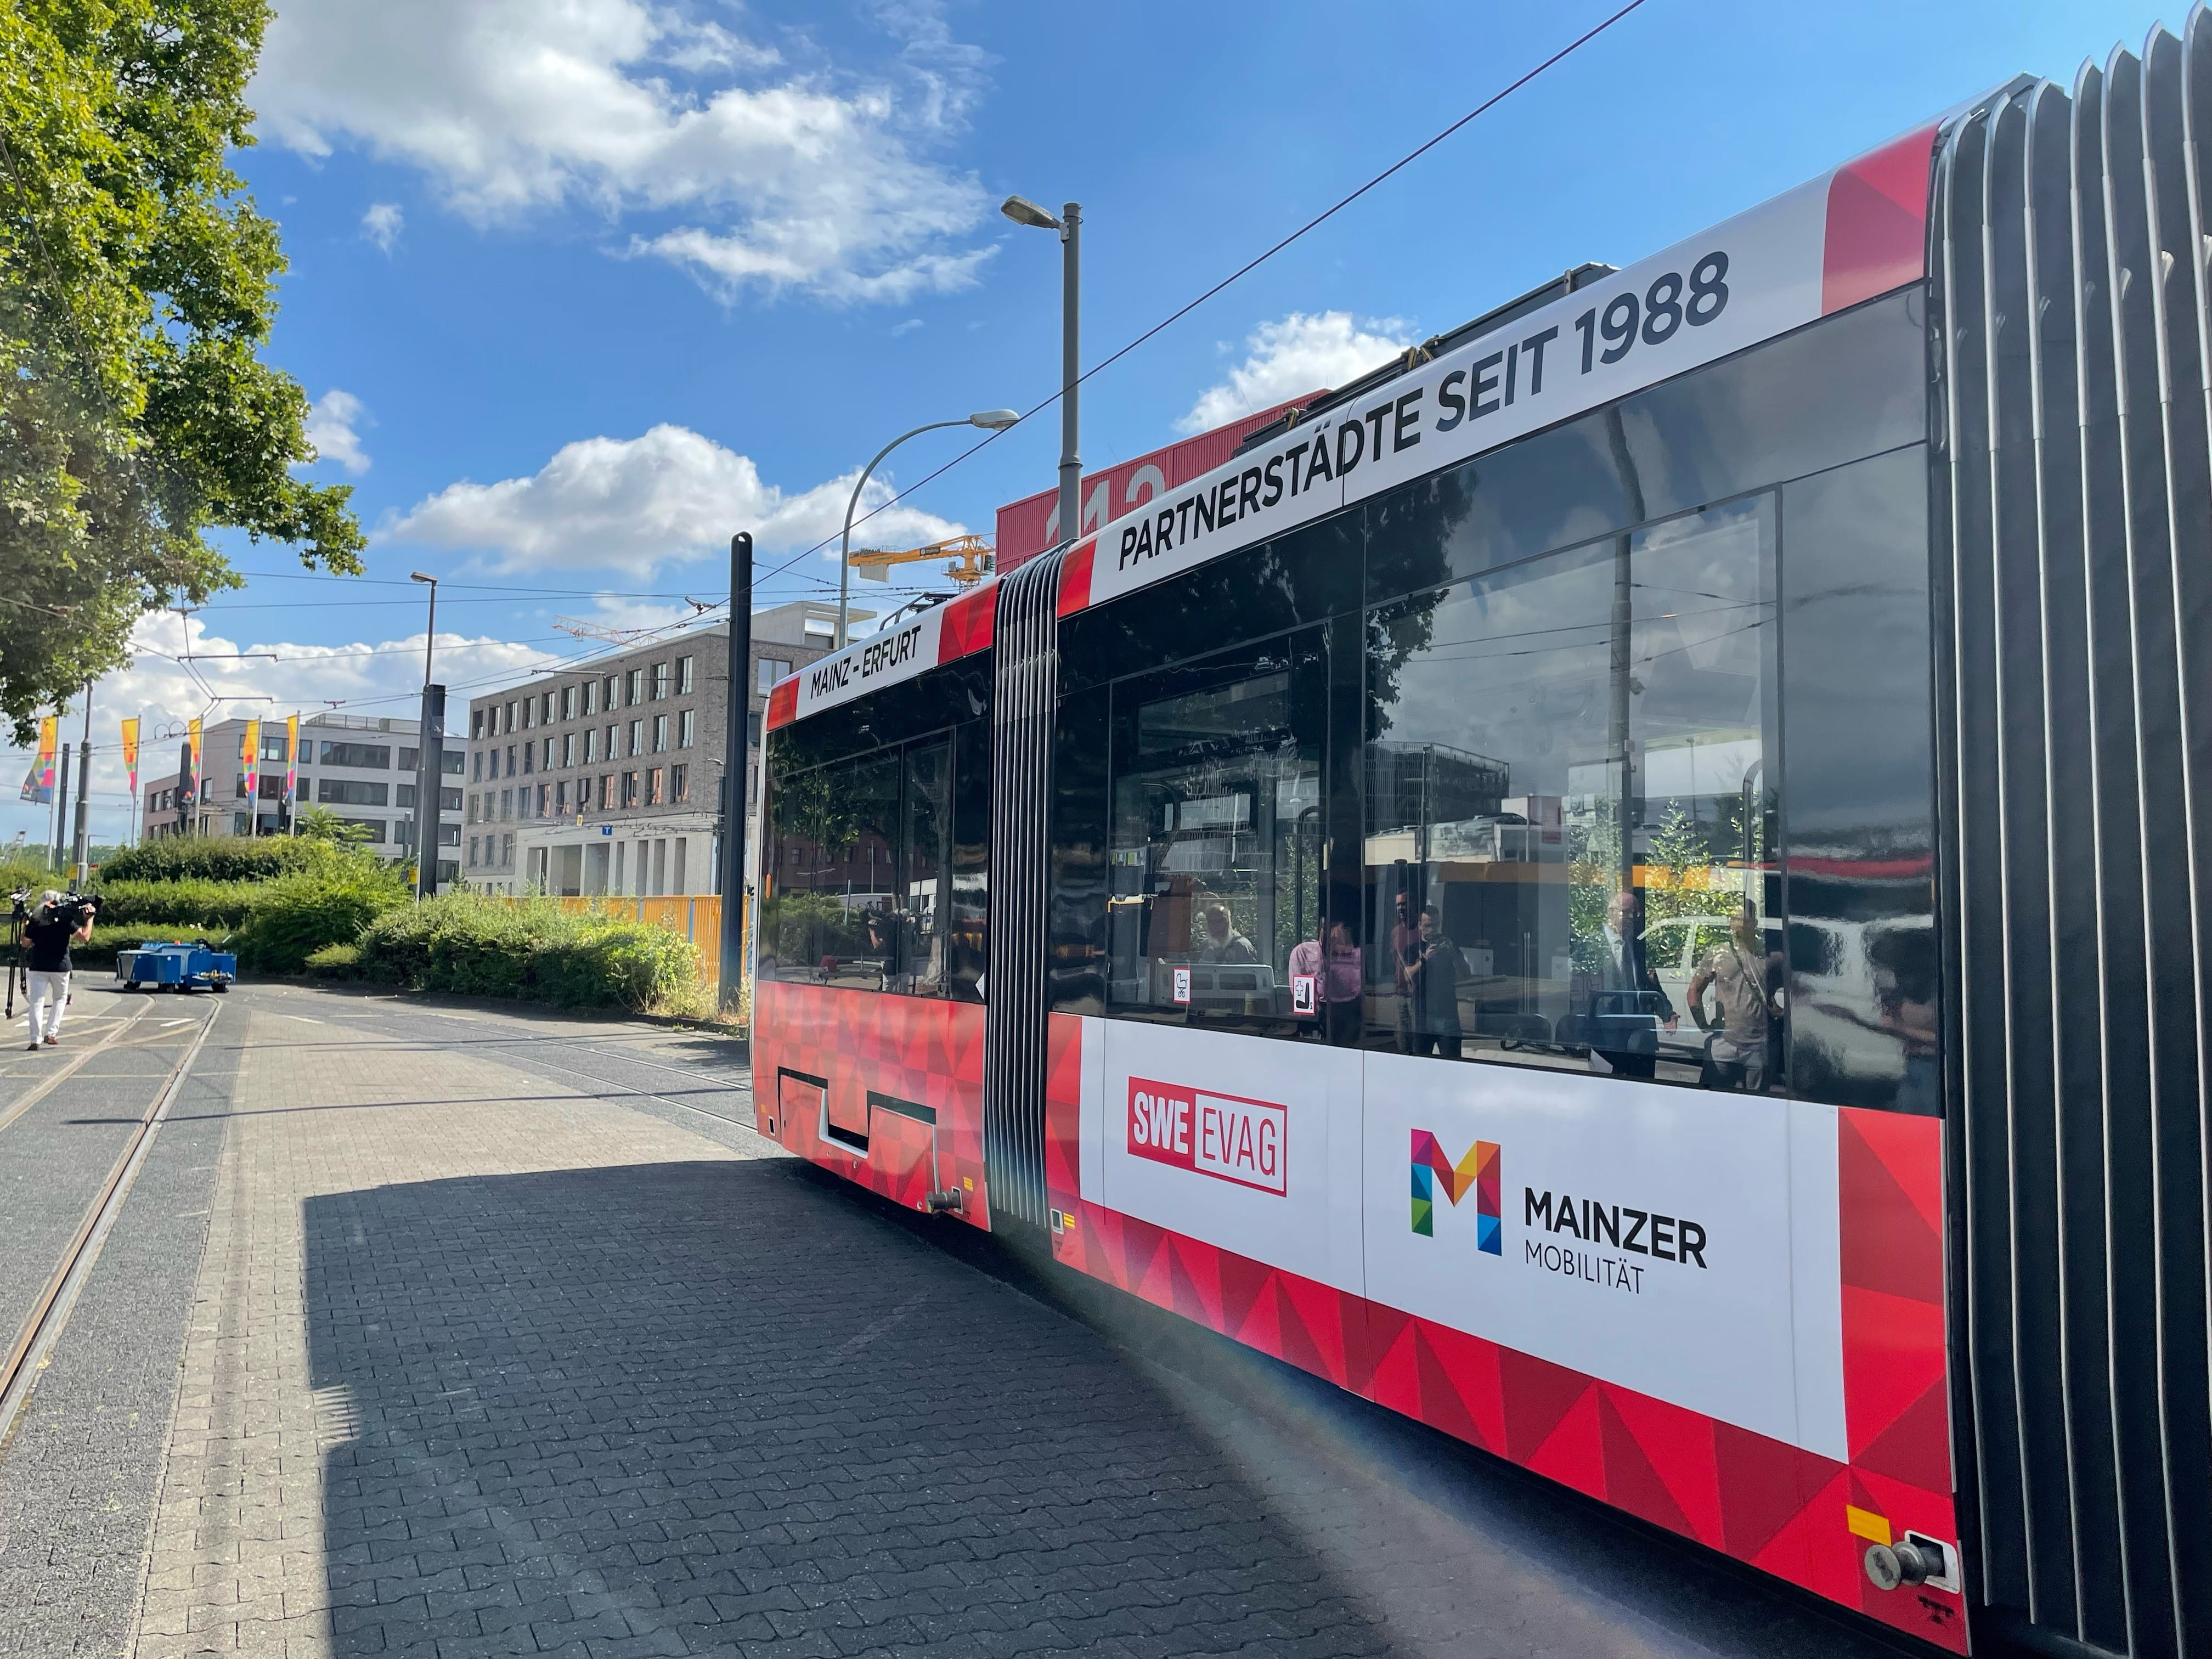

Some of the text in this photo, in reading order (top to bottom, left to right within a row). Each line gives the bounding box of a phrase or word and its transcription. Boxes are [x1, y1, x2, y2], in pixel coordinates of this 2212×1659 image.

[1119, 251, 1729, 572] PARTNERSTÄDTE SEIT 1988
[810, 656, 851, 699] MAINZ
[862, 625, 922, 679] ERFURT
[1133, 1091, 1276, 1176] SWE EVAG
[1525, 1187, 1708, 1269] MAINZER
[1525, 1239, 1645, 1295] MOBILITÄT
